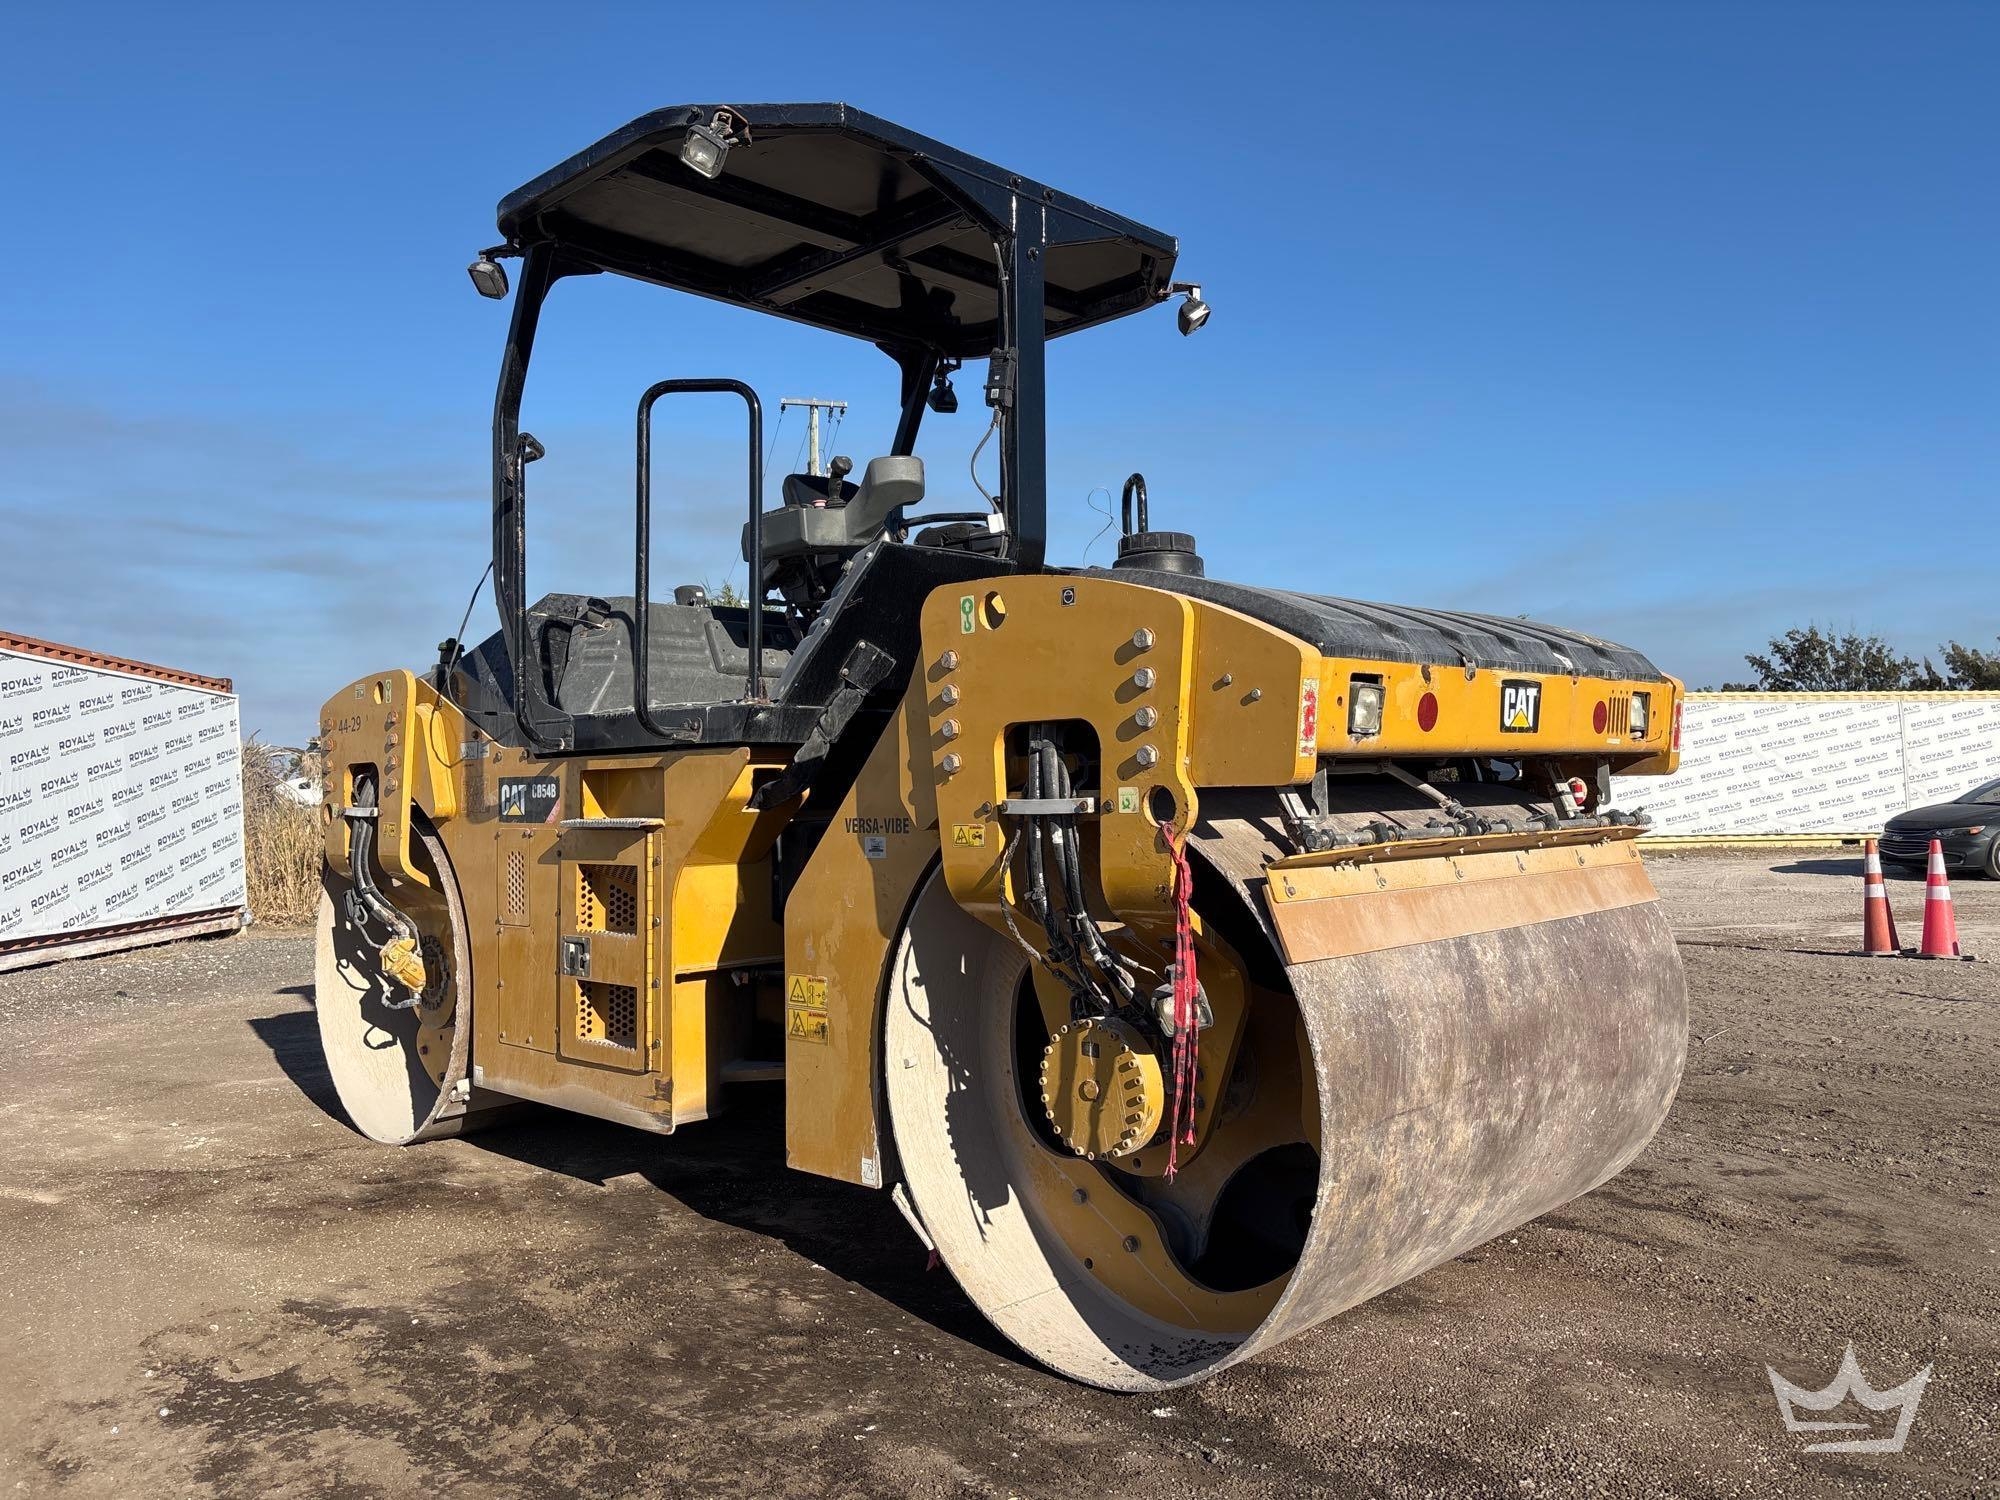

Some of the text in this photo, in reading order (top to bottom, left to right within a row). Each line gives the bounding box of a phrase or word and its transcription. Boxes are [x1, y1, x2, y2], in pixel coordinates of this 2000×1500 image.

[52, 668, 80, 681] ROYAL
[1, 677, 33, 691] ROYAL
[3, 691, 26, 699] AUCTION
[121, 687, 146, 699] ROYAL
[79, 696, 106, 709] ROYAL
[1503, 687, 1539, 727] CAT
[33, 707, 63, 721] ROYAL
[81, 708, 101, 716] AUCTION
[178, 703, 199, 714] ROYAL
[1753, 706, 1780, 715] ROYAL
[1819, 710, 1846, 718] ROYAL
[1952, 709, 1979, 718] ROYAL
[34, 720, 57, 729] AUCTION
[143, 713, 165, 725] ROYAL
[338, 716, 361, 733] 44-29
[1711, 715, 1738, 723] ROYAL
[1777, 719, 1803, 727] ROYAL
[1911, 718, 1937, 728] ROYAL
[104, 723, 129, 737] ROYAL
[1846, 721, 1872, 730] ROYAL
[199, 726, 219, 737] ROYAL
[1735, 728, 1761, 736] ROYAL
[1803, 730, 1830, 739] ROYAL
[1938, 730, 1965, 739] ROYAL
[59, 735, 88, 750] ROYAL
[165, 736, 187, 749] ROYAL
[1693, 736, 1719, 745] ROYAL
[1870, 733, 1897, 742] ROYAL
[1761, 739, 1787, 748] ROYAL
[1827, 743, 1854, 752] ROYAL
[1961, 742, 1987, 751] ROYAL
[11, 749, 41, 765] ROYAL
[61, 748, 82, 757] AUCTION
[129, 748, 152, 762] ROYAL
[217, 749, 236, 760] ROYAL
[1719, 749, 1745, 757] ROYAL
[1785, 752, 1811, 761] ROYAL
[1920, 752, 1946, 760] ROYAL
[1855, 754, 1880, 763] ROYAL
[12, 762, 36, 772] AUCTION
[87, 761, 115, 776] ROYAL
[184, 760, 205, 773] ROYAL
[1743, 761, 1769, 770] ROYAL
[1811, 764, 1839, 772] ROYAL
[1946, 763, 1973, 772] ROYAL
[89, 773, 109, 783] AUCTION
[150, 772, 172, 786] ROYAL
[1700, 770, 1726, 779] ROYAL
[1768, 773, 1795, 782] ROYAL
[41, 776, 71, 792] ROYAL
[1659, 779, 1685, 788] ROYAL
[1835, 776, 1862, 785] ROYAL
[205, 781, 225, 794] ROYAL
[1727, 782, 1752, 791] ROYAL
[1792, 785, 1819, 794] ROYAL
[1927, 784, 1956, 794] ROYAL
[44, 789, 66, 799] AUCTION
[112, 786, 137, 801] ROYAL
[1617, 789, 1644, 798] ROYAL
[1685, 792, 1711, 800] ROYAL
[1862, 788, 1888, 797] ROYAL
[172, 794, 193, 808] ROYAL
[501, 785, 527, 816] CAT
[1750, 795, 1776, 803] ROYAL
[1819, 797, 1846, 806] ROYAL
[68, 802, 96, 818] ROYAL
[1708, 804, 1734, 813] ROYAL
[1776, 806, 1803, 815] ROYAL
[1843, 809, 1869, 818] ROYAL
[70, 814, 91, 825] AUCTION
[137, 809, 159, 824] ROYAL
[1666, 813, 1692, 822] ROYAL
[1734, 815, 1761, 824] ROYAL
[20, 819, 51, 837] ROYAL
[191, 816, 212, 830] ROYAL
[845, 817, 910, 834] VERSA-VIBE
[1800, 819, 1826, 828] ROYAL
[22, 833, 45, 845] AUCTION
[96, 825, 123, 842] ROYAL
[158, 831, 179, 846] ROYAL
[98, 837, 118, 848] AUCTION
[212, 835, 232, 849] ROYAL
[51, 843, 80, 862] ROYAL
[121, 848, 145, 865] ROYAL
[53, 856, 75, 868] AUCTION
[180, 851, 201, 866] ROYAL
[2, 864, 33, 884] ROYAL
[78, 867, 105, 886] ROYAL
[145, 869, 168, 886] ROYAL
[199, 870, 219, 886] ROYAL
[4, 878, 27, 891] AUCTION
[79, 880, 100, 892] AUCTION
[31, 889, 61, 909] ROYAL
[105, 888, 131, 907] ROYAL
[166, 889, 188, 906] ROYAL
[220, 888, 238, 904] ROYAL
[33, 902, 55, 916] AUCTION
[63, 910, 90, 928] ROYAL
